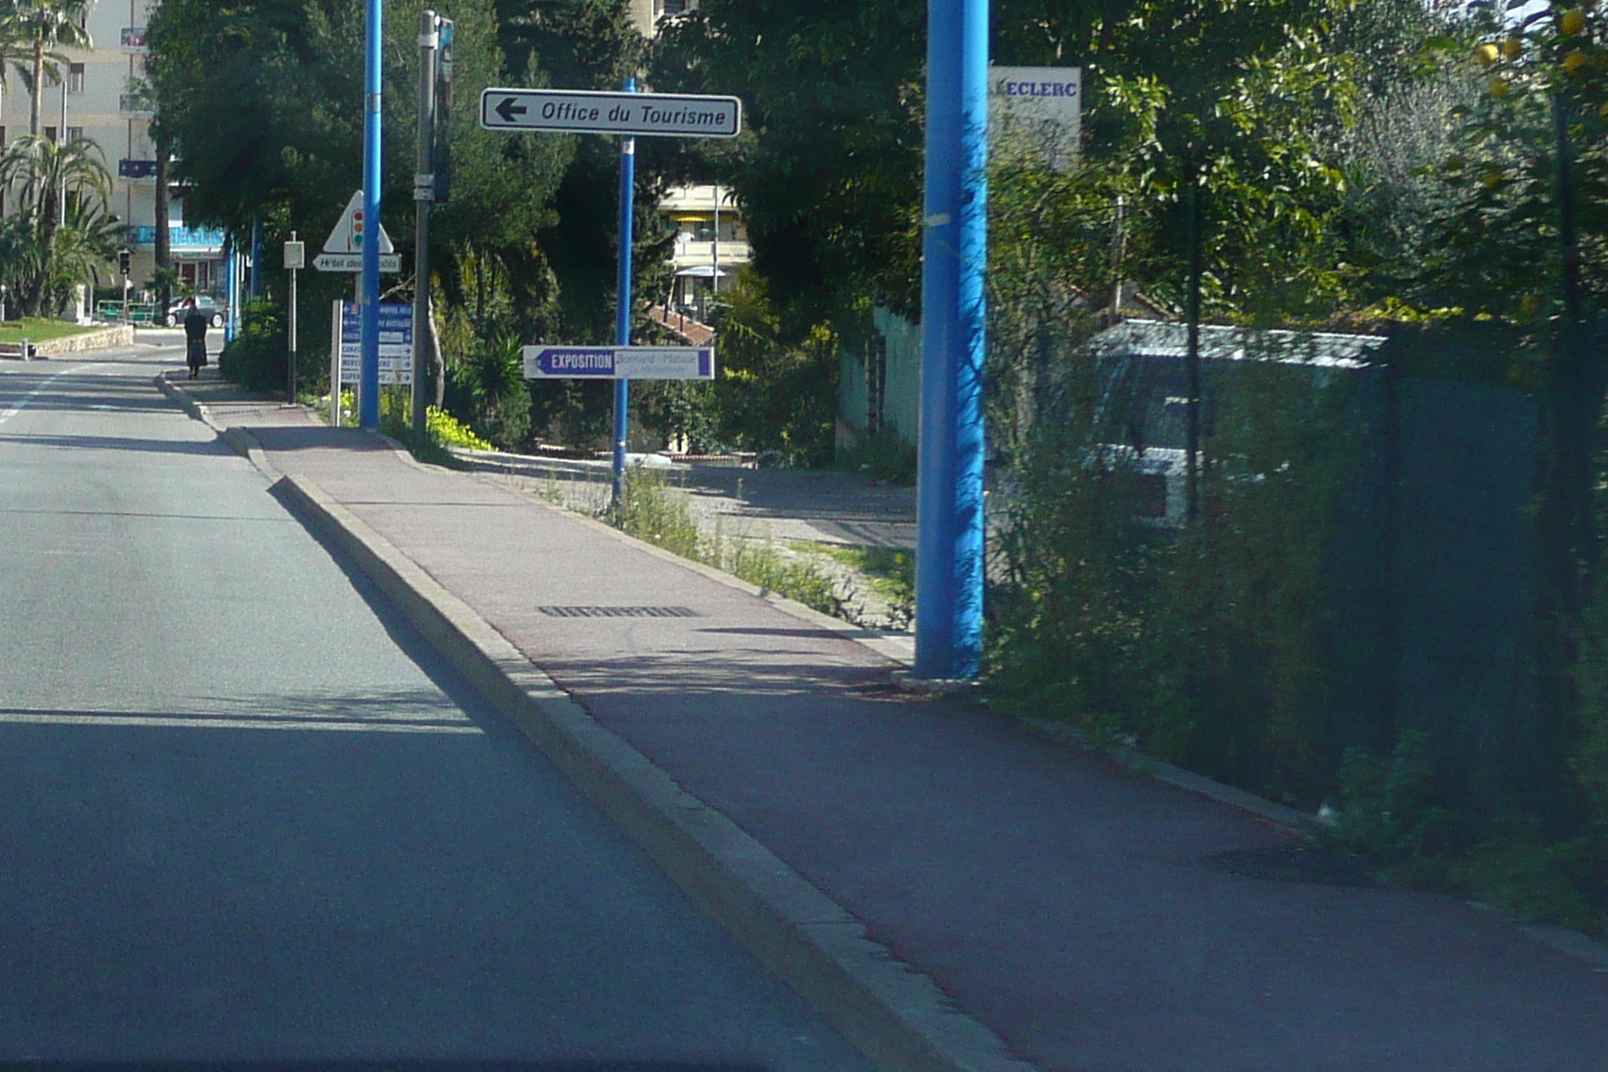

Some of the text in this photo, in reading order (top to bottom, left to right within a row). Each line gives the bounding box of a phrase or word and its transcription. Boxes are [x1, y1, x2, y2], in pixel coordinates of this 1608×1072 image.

[542, 102, 726, 126] Office du Tourisme
[551, 353, 613, 369] EXPOSITION
